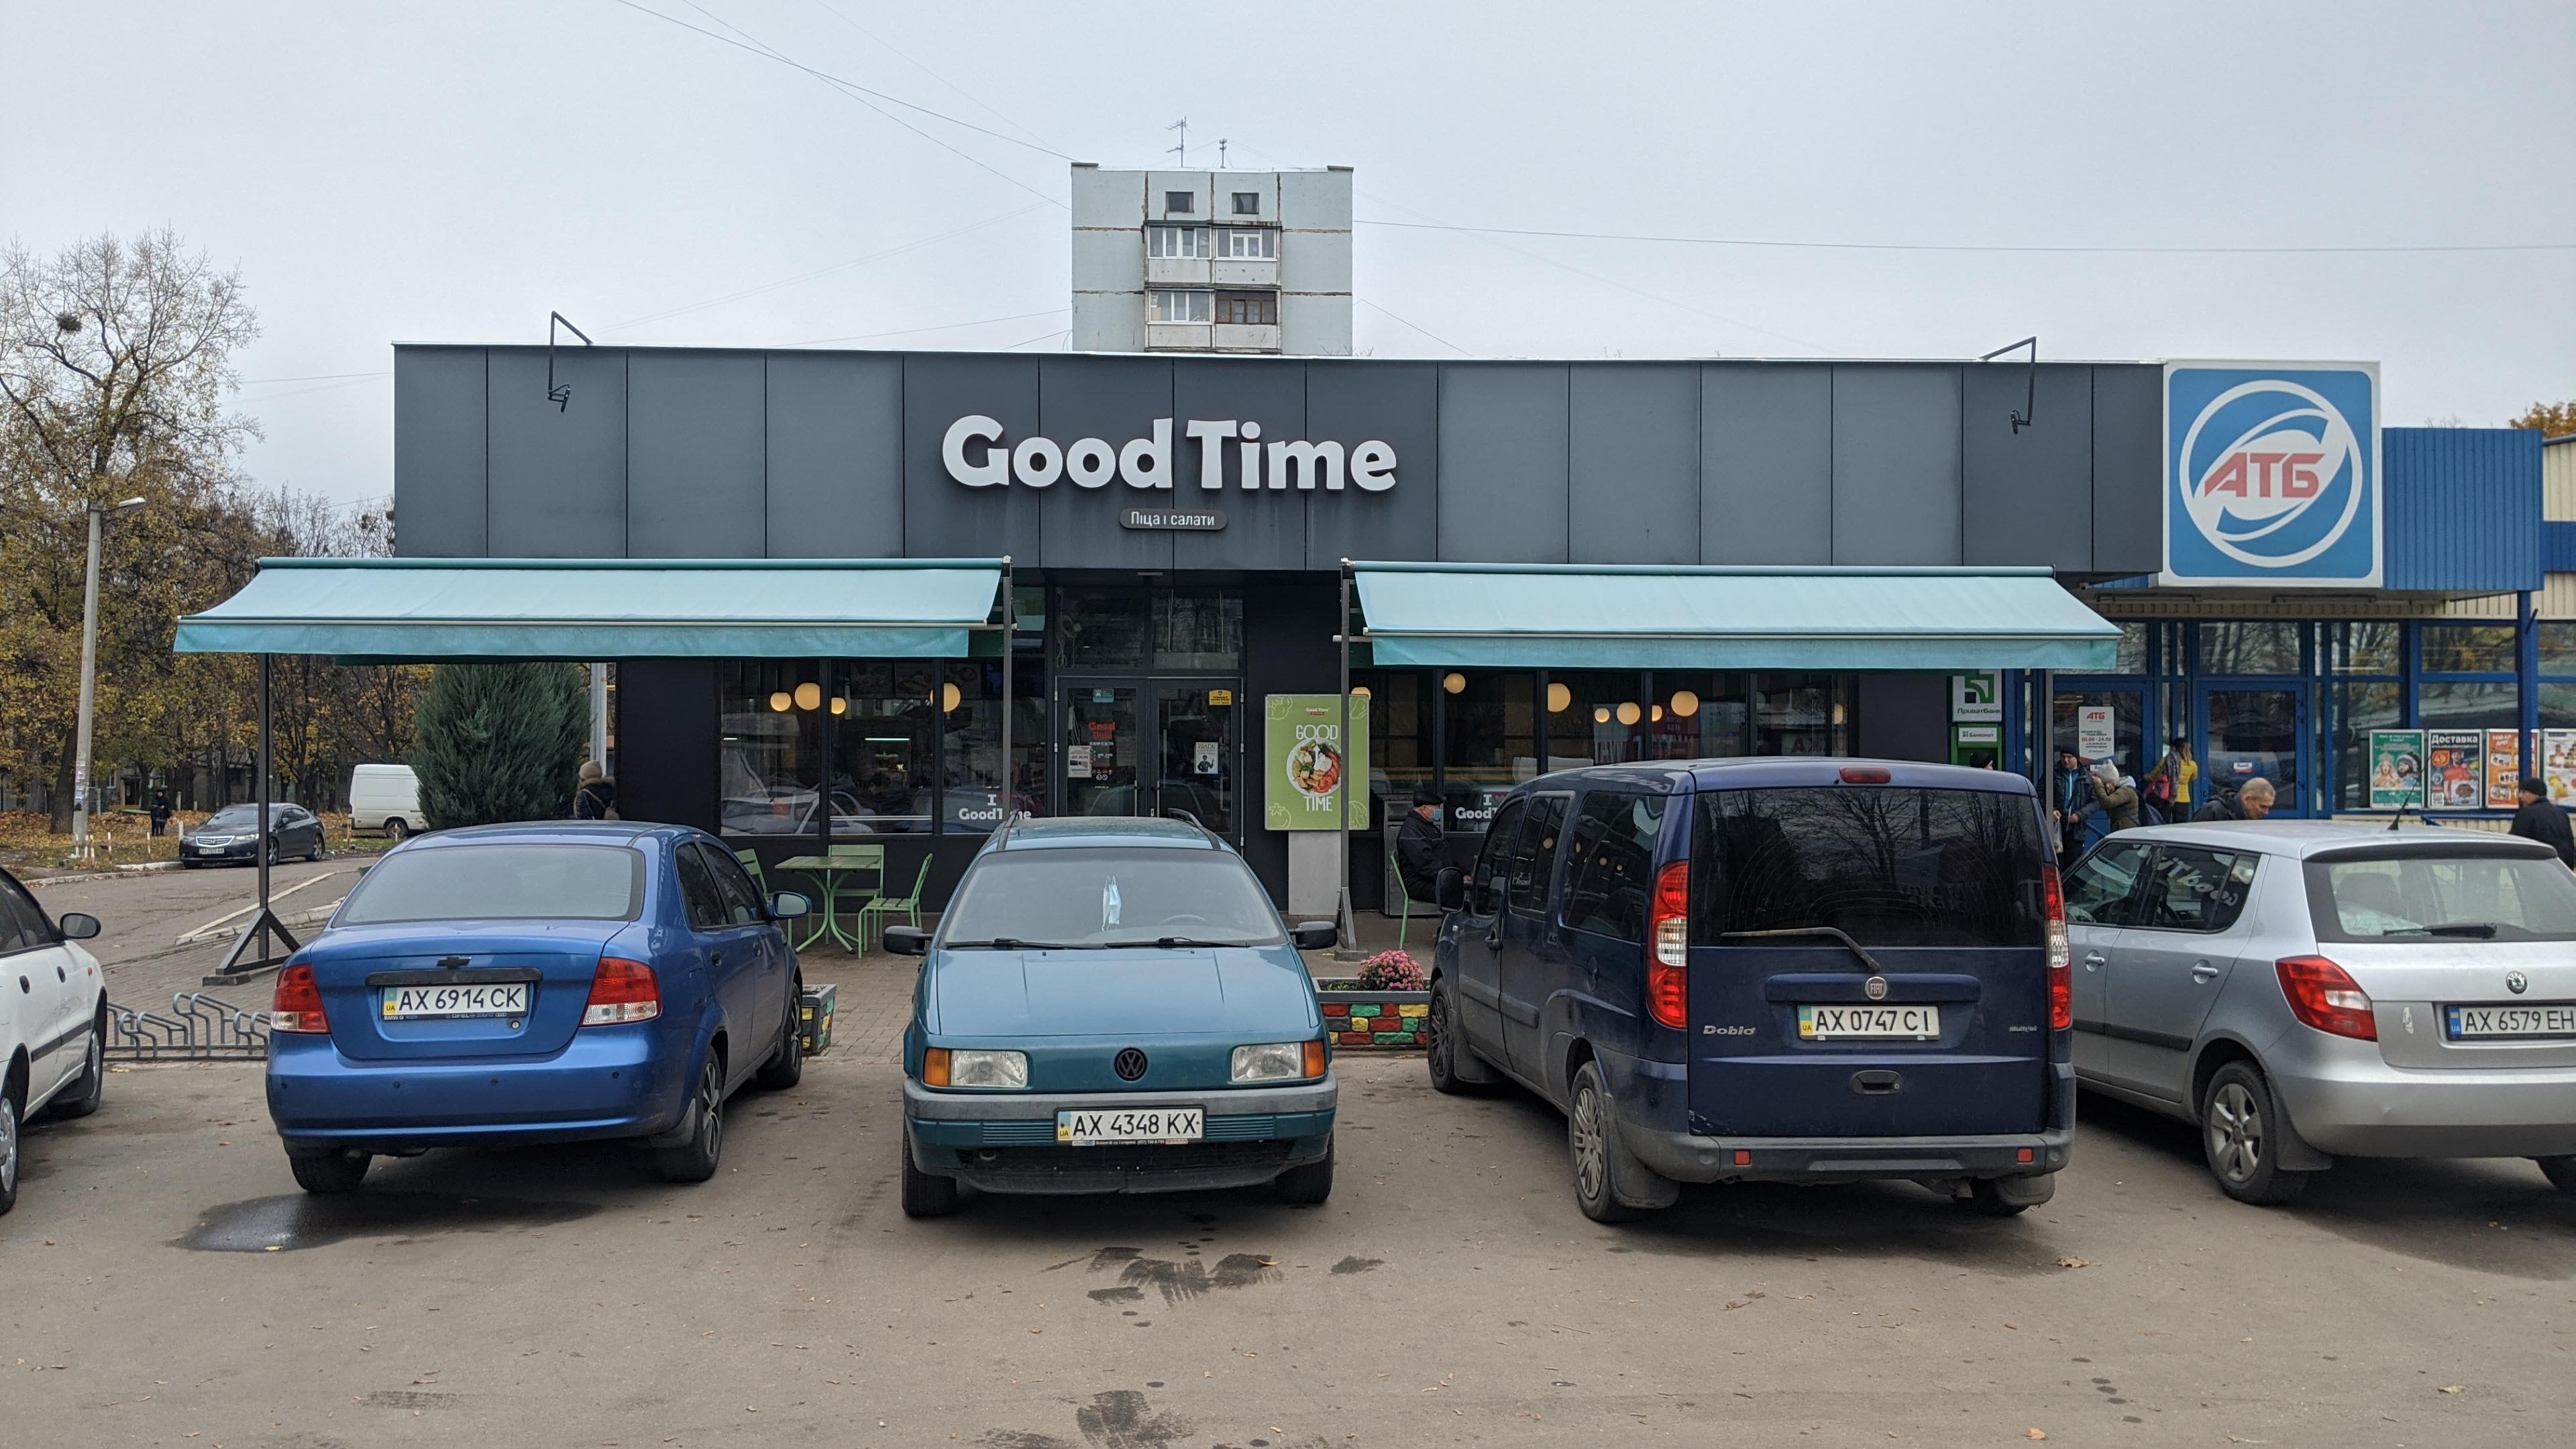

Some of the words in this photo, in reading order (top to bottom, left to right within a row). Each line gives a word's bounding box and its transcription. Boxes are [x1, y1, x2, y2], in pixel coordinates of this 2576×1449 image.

[943, 415, 1173, 489] Good
[1185, 419, 1397, 491] Time
[2204, 451, 2326, 498] АТБ
[1131, 511, 1160, 527] Піца
[1171, 515, 1215, 526] салати
[2086, 712, 2106, 720] АТБ
[1295, 724, 1338, 740] GOOD
[2431, 735, 2478, 745] Доставка
[1303, 796, 1334, 812] TIME
[1870, 983, 1883, 994] FIAT
[398, 990, 430, 1011] AX
[435, 988, 484, 1010] 6914
[490, 987, 522, 1008] CK
[1815, 1010, 1845, 1031] AX
[1850, 1010, 1897, 1032] 0747
[1904, 1010, 1929, 1032] CI
[2465, 1011, 2493, 1032] AX
[2498, 1010, 2541, 1030] 6579
[2546, 1010, 2575, 1030] EH
[1073, 1115, 1103, 1136] AX
[1110, 1114, 1159, 1135] 4348
[1167, 1113, 1197, 1134] KX
